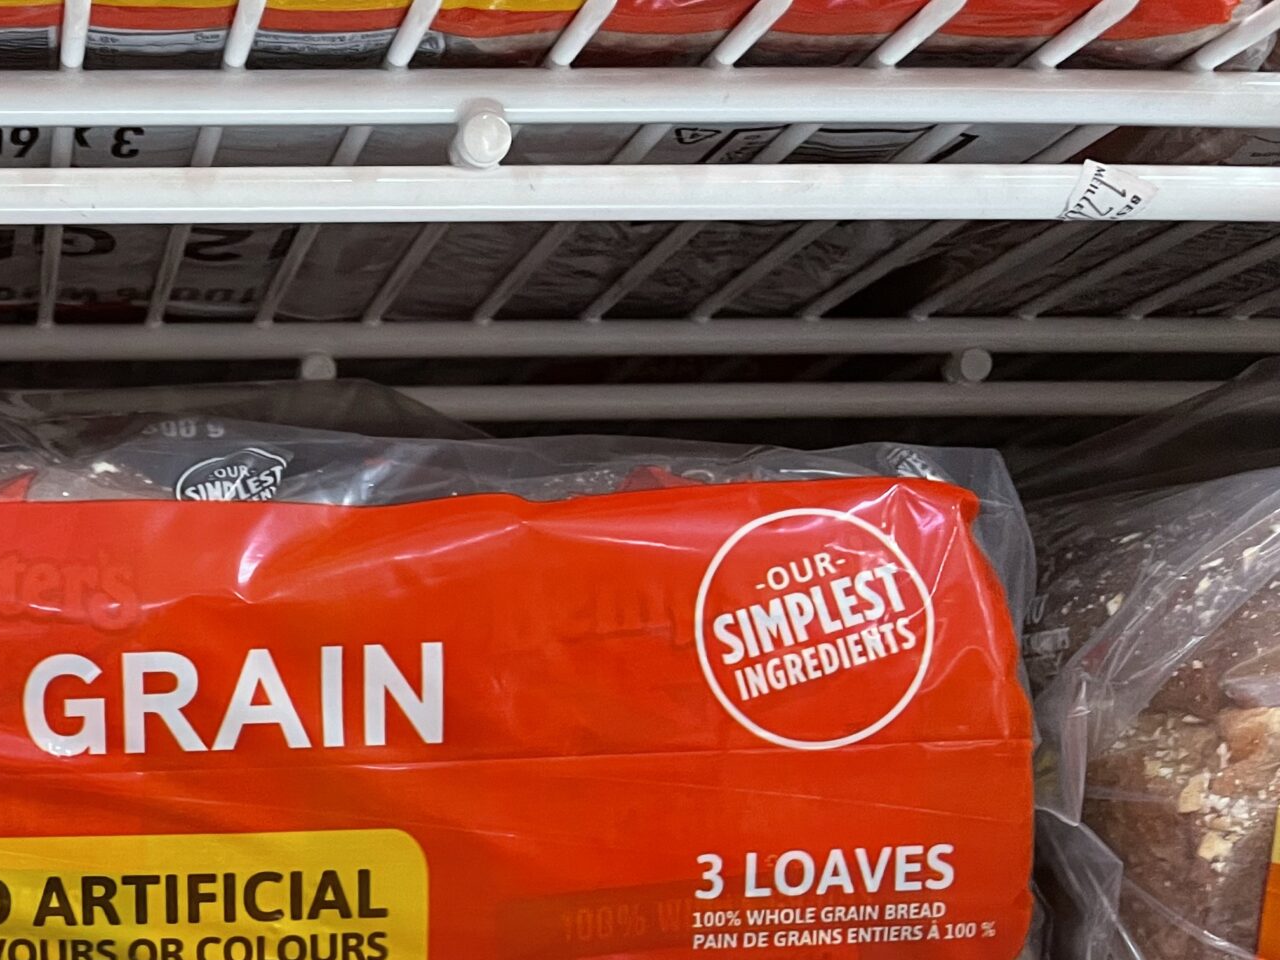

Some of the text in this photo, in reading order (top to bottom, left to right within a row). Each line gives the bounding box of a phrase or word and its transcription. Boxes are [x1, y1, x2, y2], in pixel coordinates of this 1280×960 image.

[1110, 194, 1142, 219] BES
[713, 562, 908, 665] SIMPLEST
[734, 616, 917, 702] INGREDIENTS
[23, 642, 445, 757] GRAIN
[33, 868, 388, 928] ARTIFICIAL
[695, 843, 956, 900] 3 LOAVES
[692, 910, 741, 929] 100%
[746, 907, 817, 926] WHOLE
[820, 904, 880, 924] GRAIN
[884, 900, 946, 921] BREAD
[692, 932, 738, 951] PAIN
[742, 930, 768, 949] DE
[773, 928, 842, 948] GRAINS
[847, 924, 922, 945] ENTIERS
[945, 923, 977, 940] 100
[981, 922, 996, 938] %
